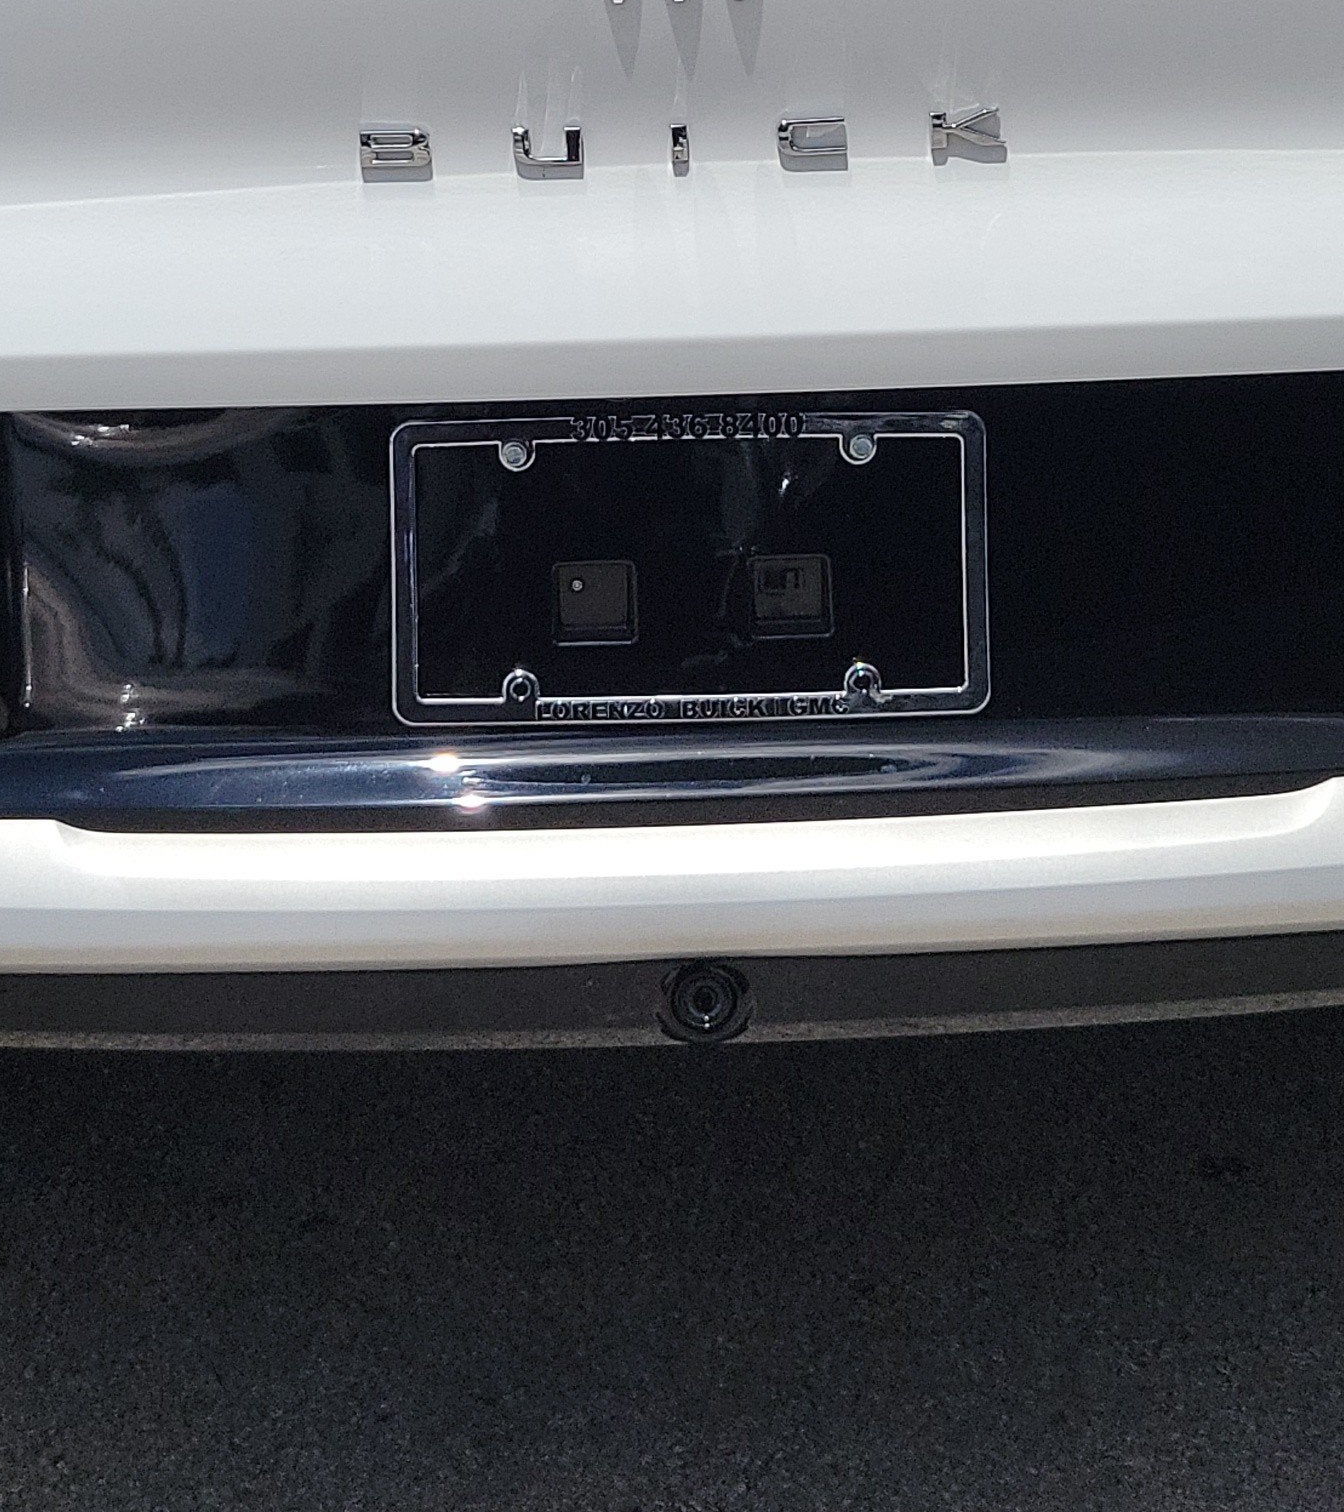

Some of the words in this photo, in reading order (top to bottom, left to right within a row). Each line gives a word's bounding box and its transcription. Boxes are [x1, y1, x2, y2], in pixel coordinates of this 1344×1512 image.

[359, 106, 1008, 170] BUICK
[536, 696, 663, 721] LORENZO
[680, 695, 767, 719] BUICK
[785, 693, 850, 716] GMC
